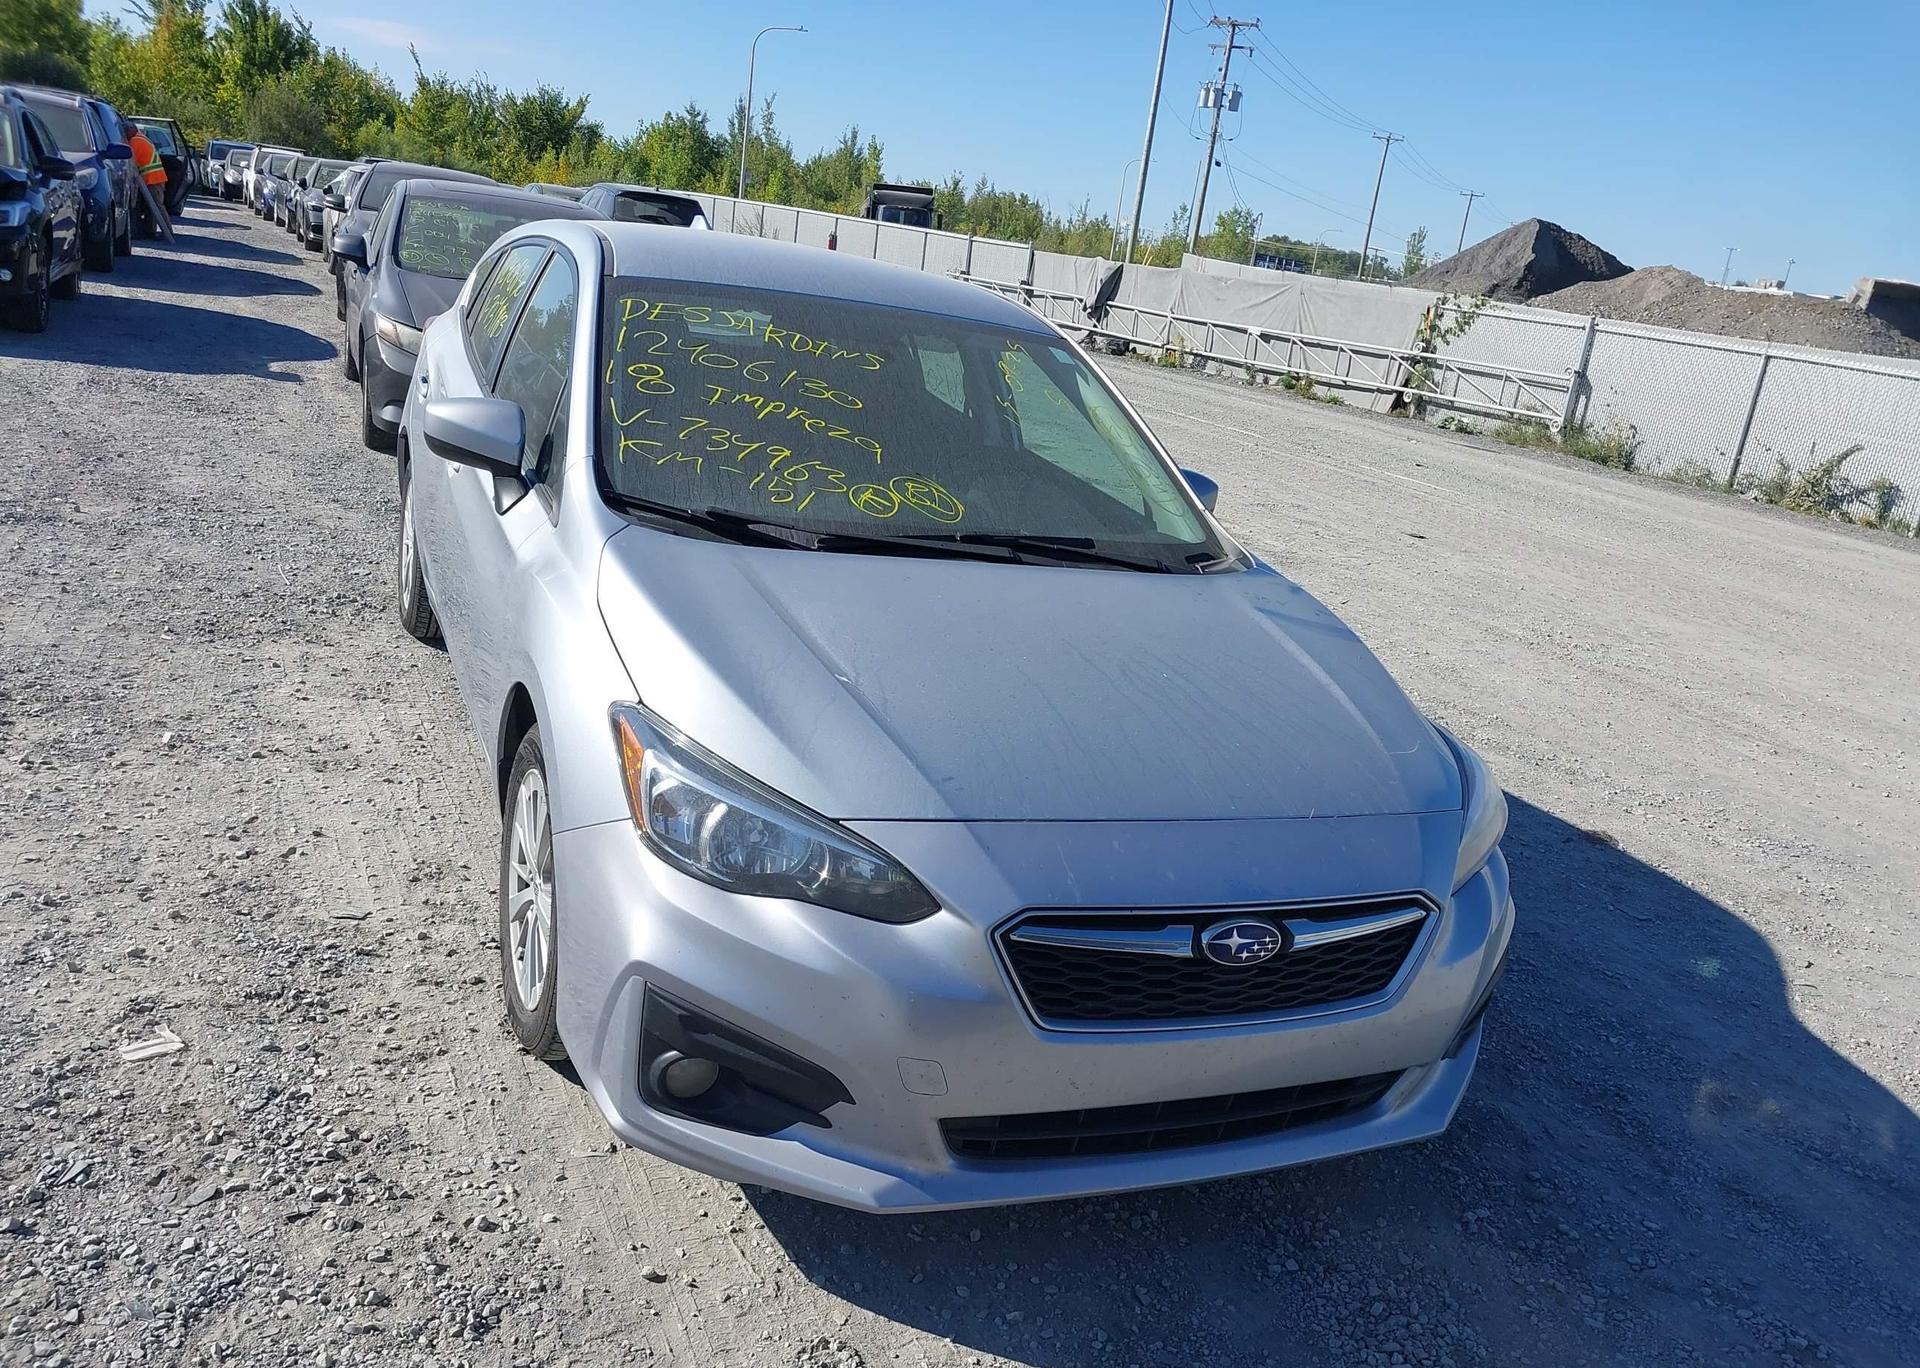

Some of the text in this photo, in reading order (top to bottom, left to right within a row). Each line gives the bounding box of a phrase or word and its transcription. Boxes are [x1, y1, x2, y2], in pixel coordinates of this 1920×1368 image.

[617, 327, 863, 409] 12406130
[619, 298, 885, 371] DESJARDINS
[606, 360, 881, 464] 18 Impreza
